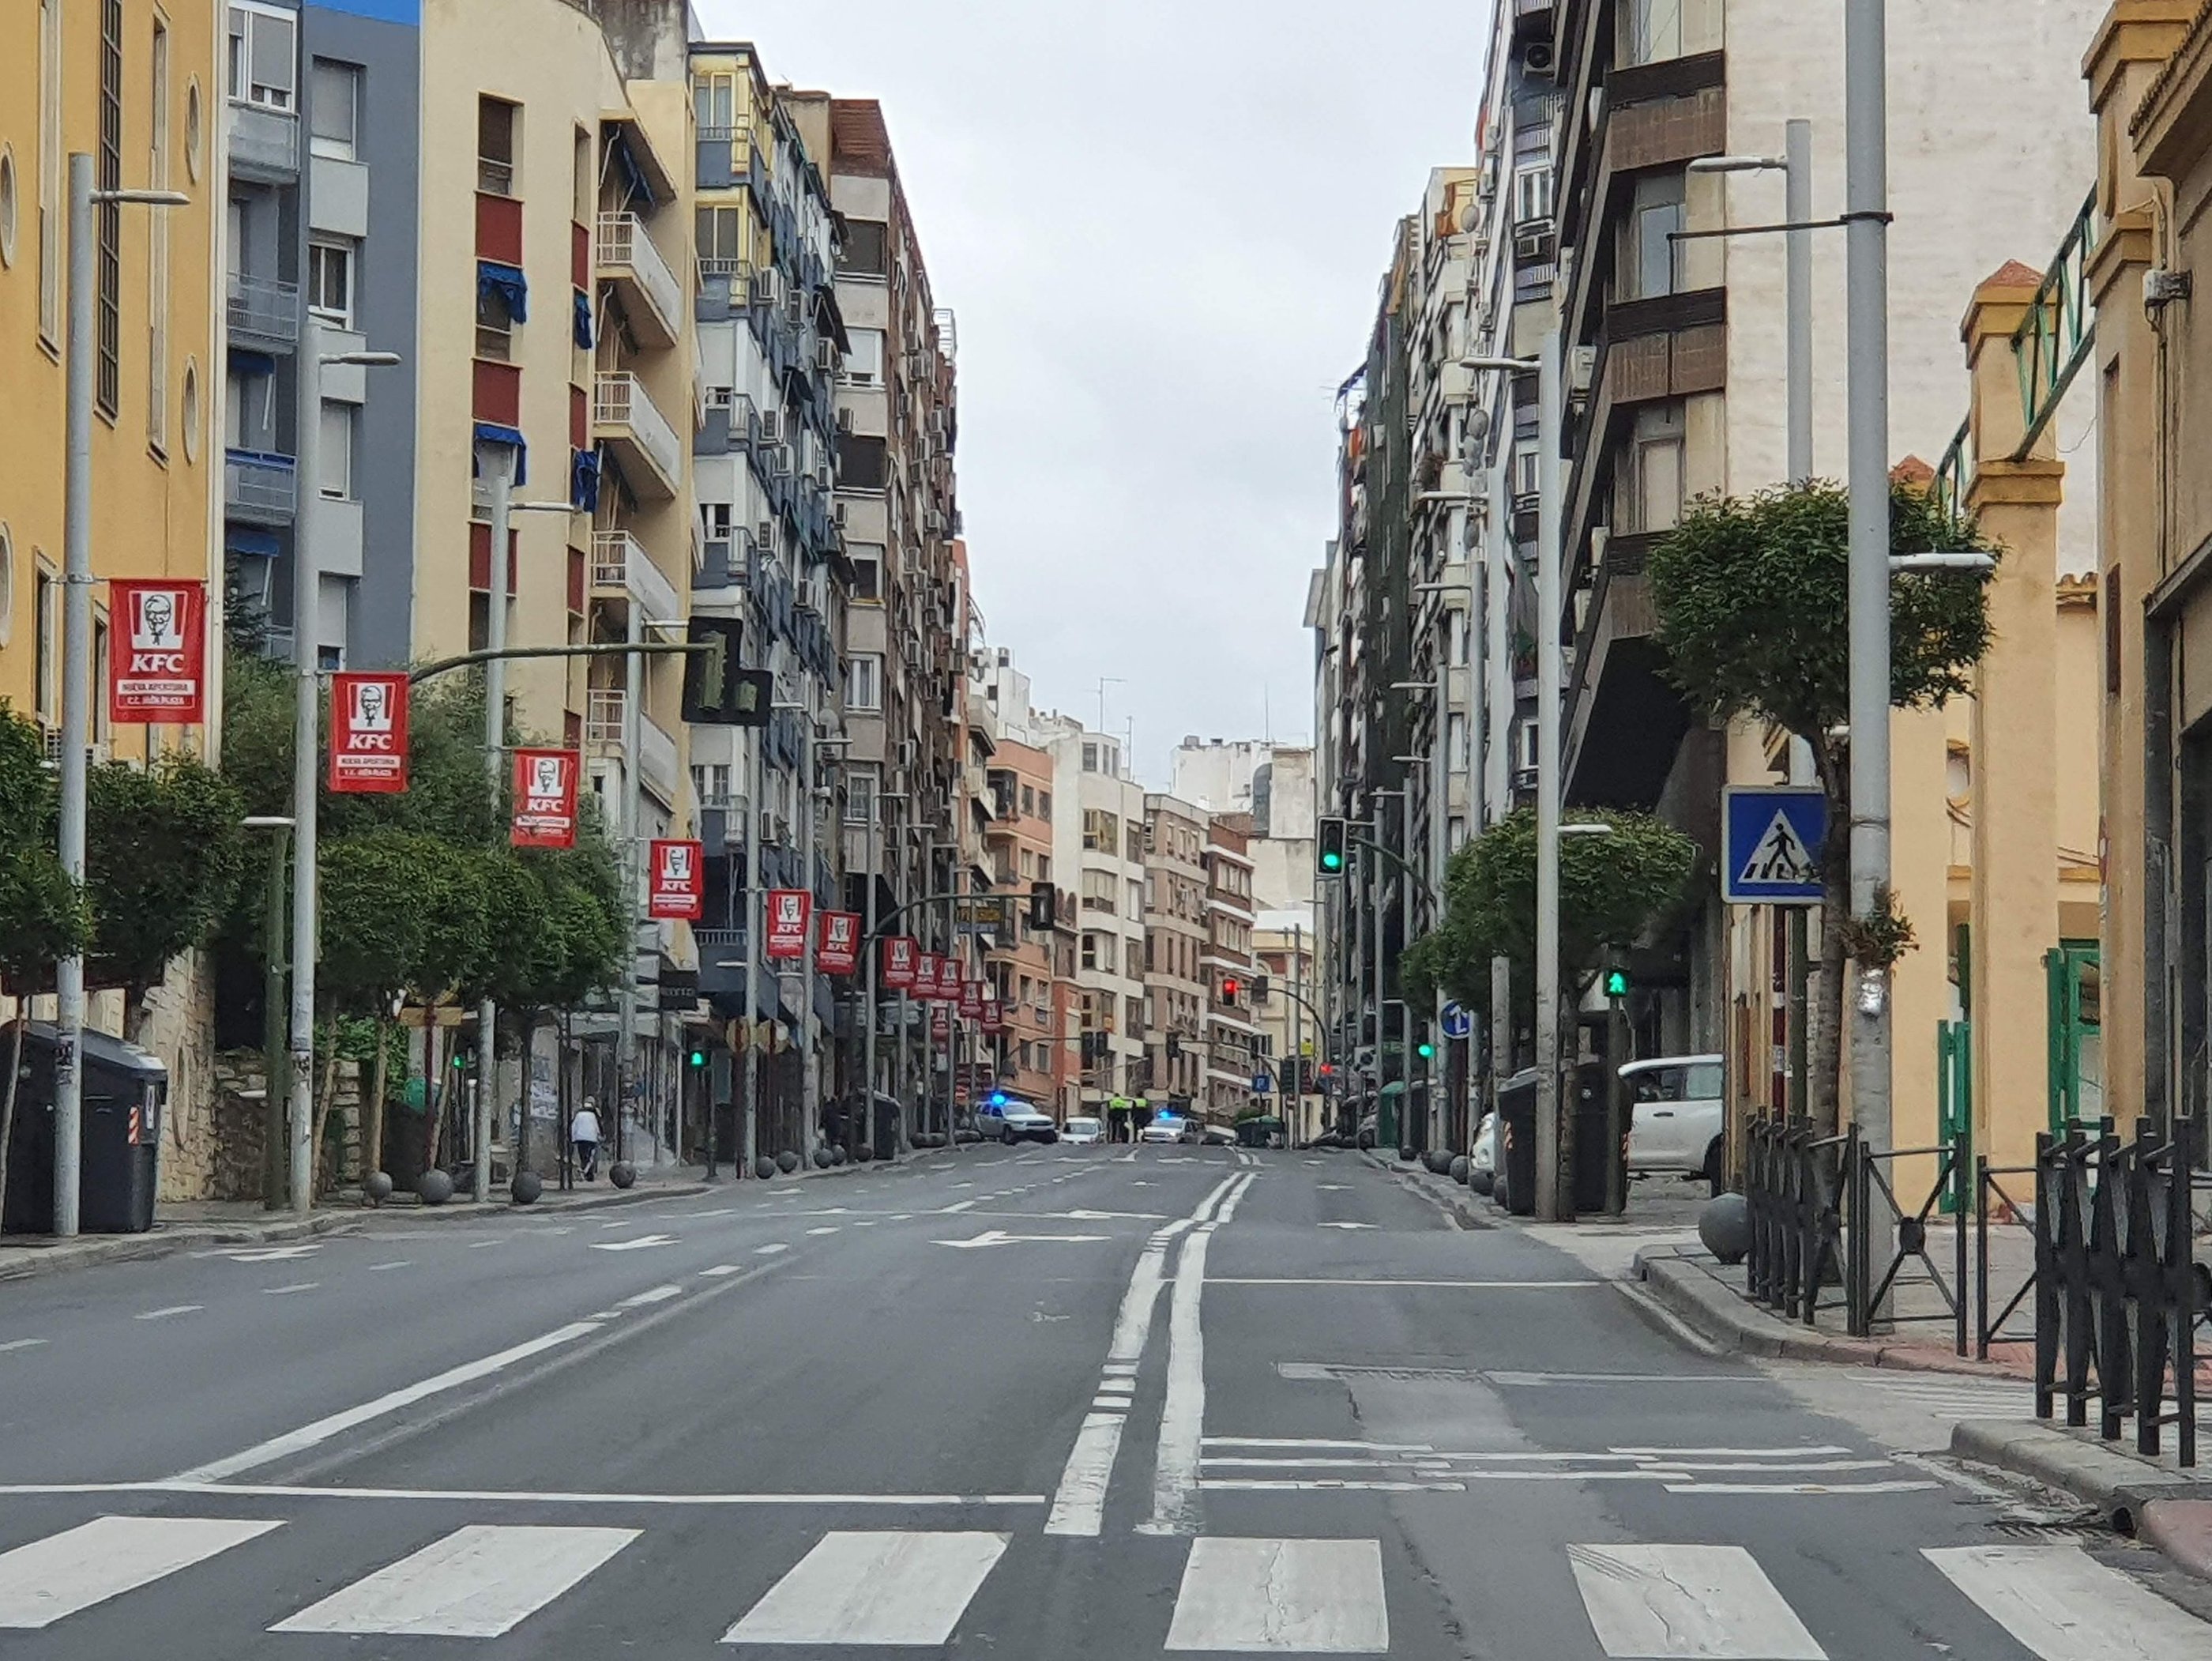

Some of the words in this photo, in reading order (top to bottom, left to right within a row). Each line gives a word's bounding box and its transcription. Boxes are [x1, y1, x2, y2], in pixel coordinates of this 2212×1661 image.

[130, 653, 184, 672] KFC
[346, 733, 393, 751] KFC
[527, 798, 565, 812] KFC
[660, 880, 692, 892] KFC
[777, 923, 803, 933] KFC
